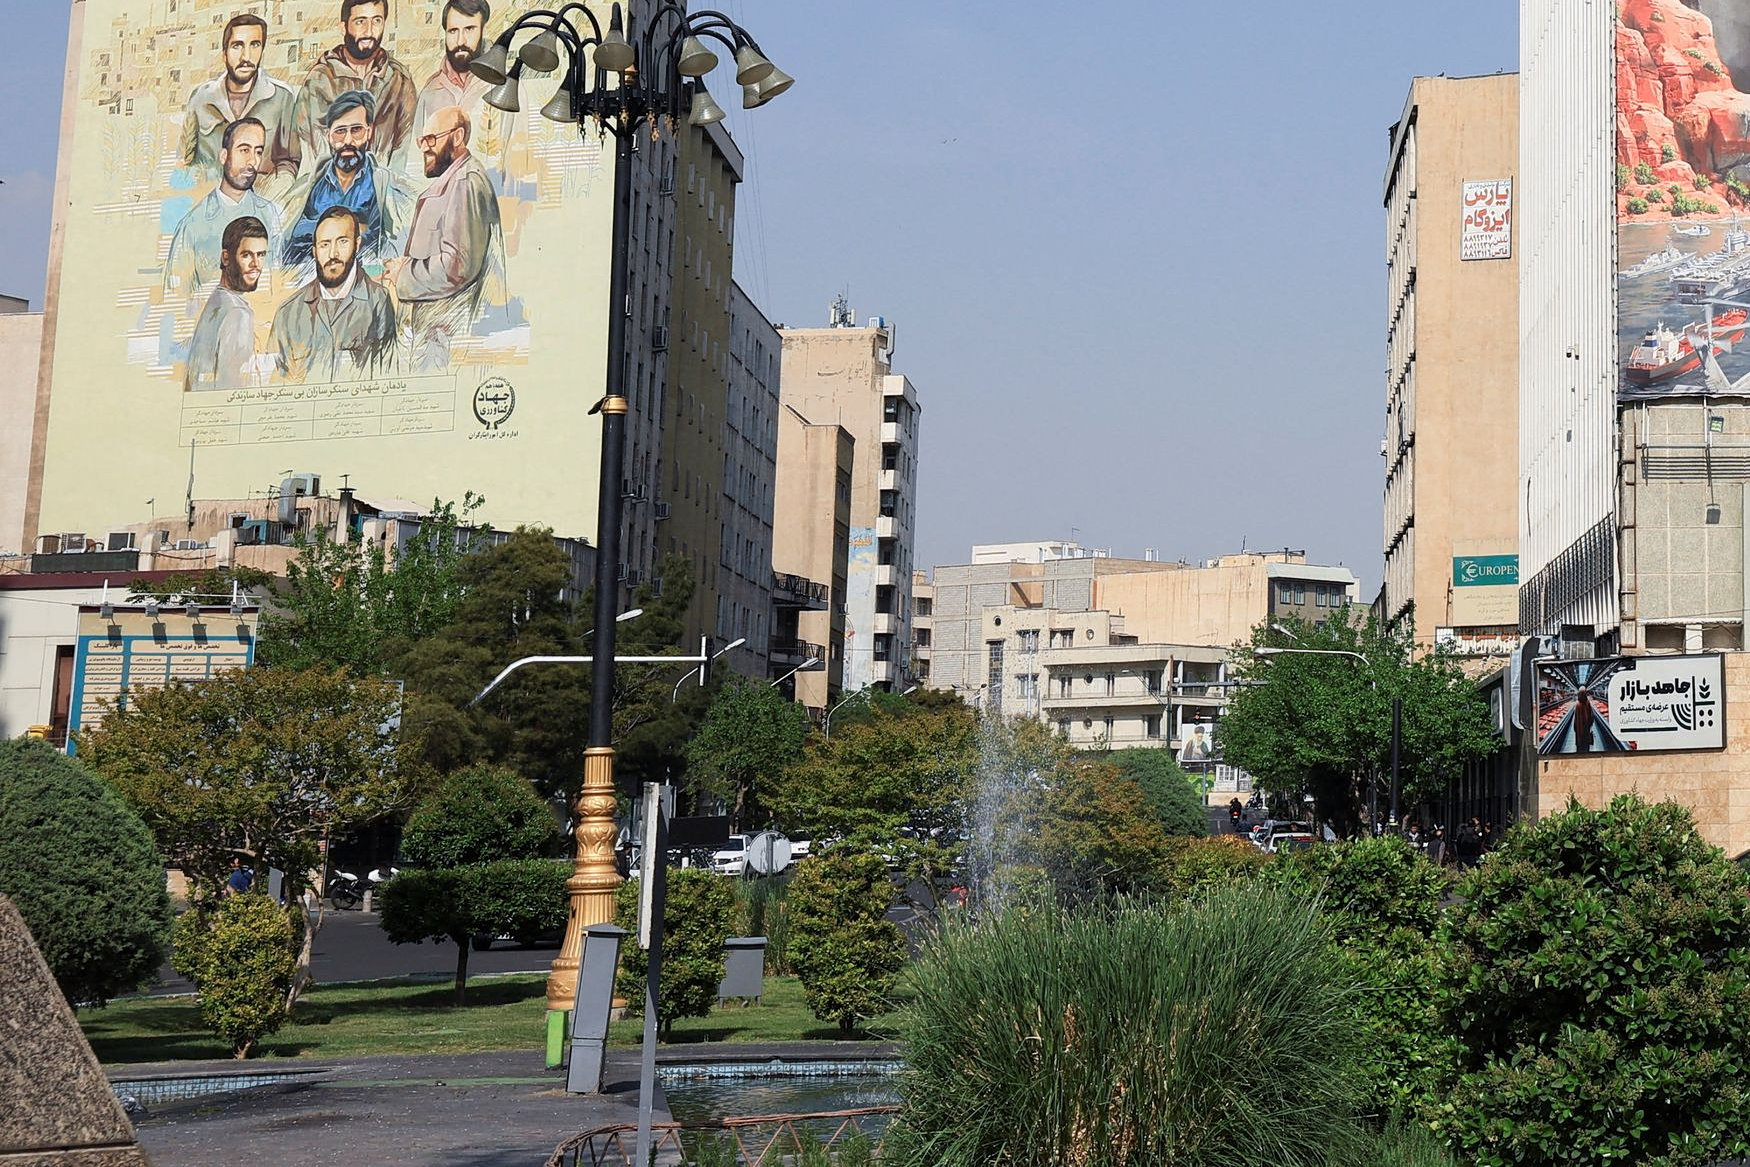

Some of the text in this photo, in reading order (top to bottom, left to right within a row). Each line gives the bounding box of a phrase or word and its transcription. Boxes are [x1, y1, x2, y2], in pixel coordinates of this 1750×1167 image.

[1465, 182, 1509, 207] پارس
[1464, 208, 1510, 232] ایزوگام
[478, 391, 510, 405] جهاد
[480, 404, 509, 416] کشاورزی
[1620, 678, 1691, 702] جاهد بازار
[1620, 703, 1646, 716] مستقیم
